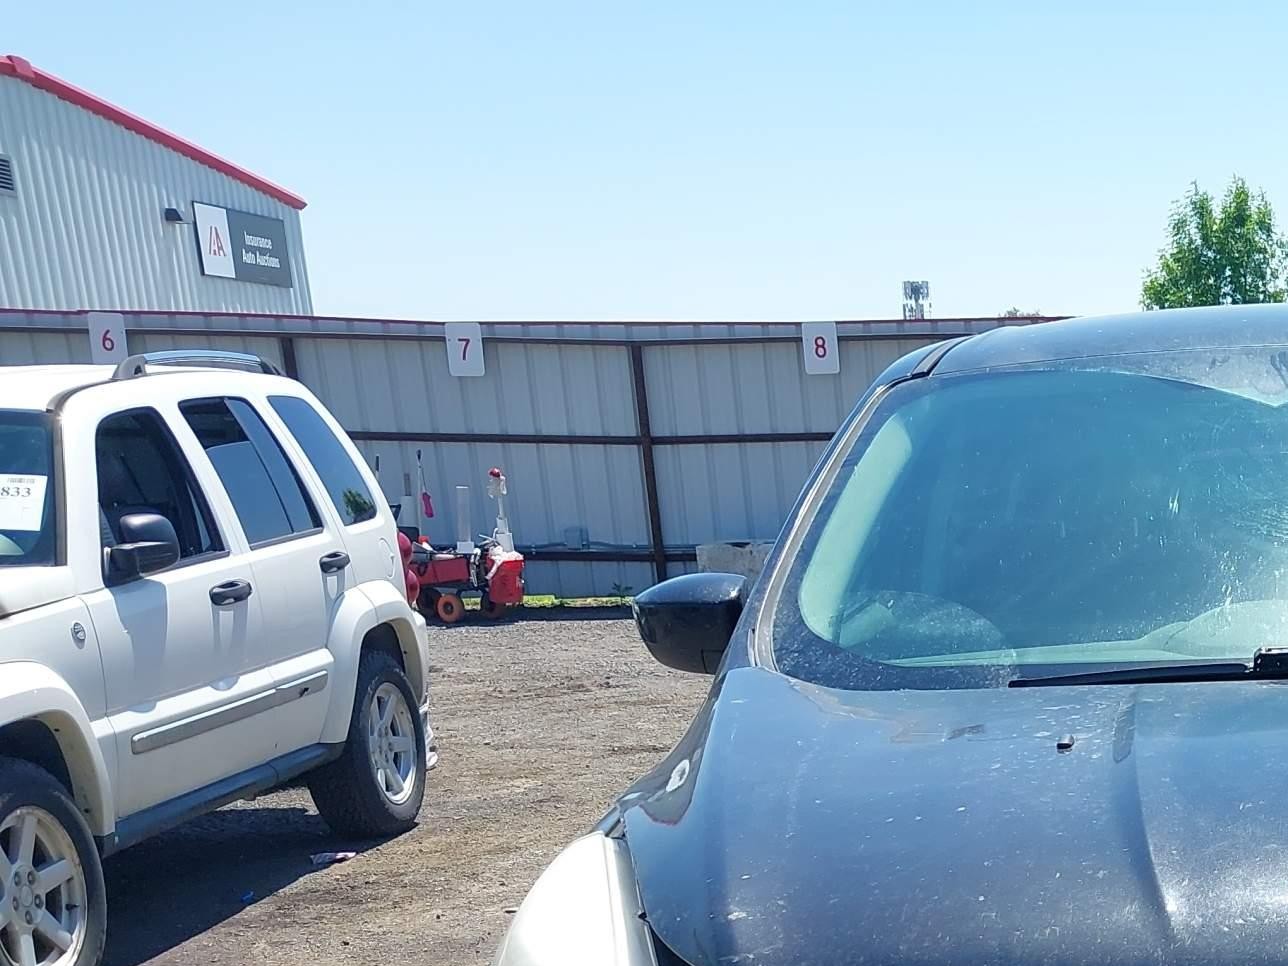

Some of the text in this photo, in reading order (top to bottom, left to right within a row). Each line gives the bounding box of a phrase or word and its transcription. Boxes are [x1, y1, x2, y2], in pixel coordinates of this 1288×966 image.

[244, 230, 273, 250] Insurance
[242, 248, 281, 268] Auto Auctions
[102, 328, 115, 352] 6
[457, 337, 471, 361] 7
[814, 335, 827, 359] 8
